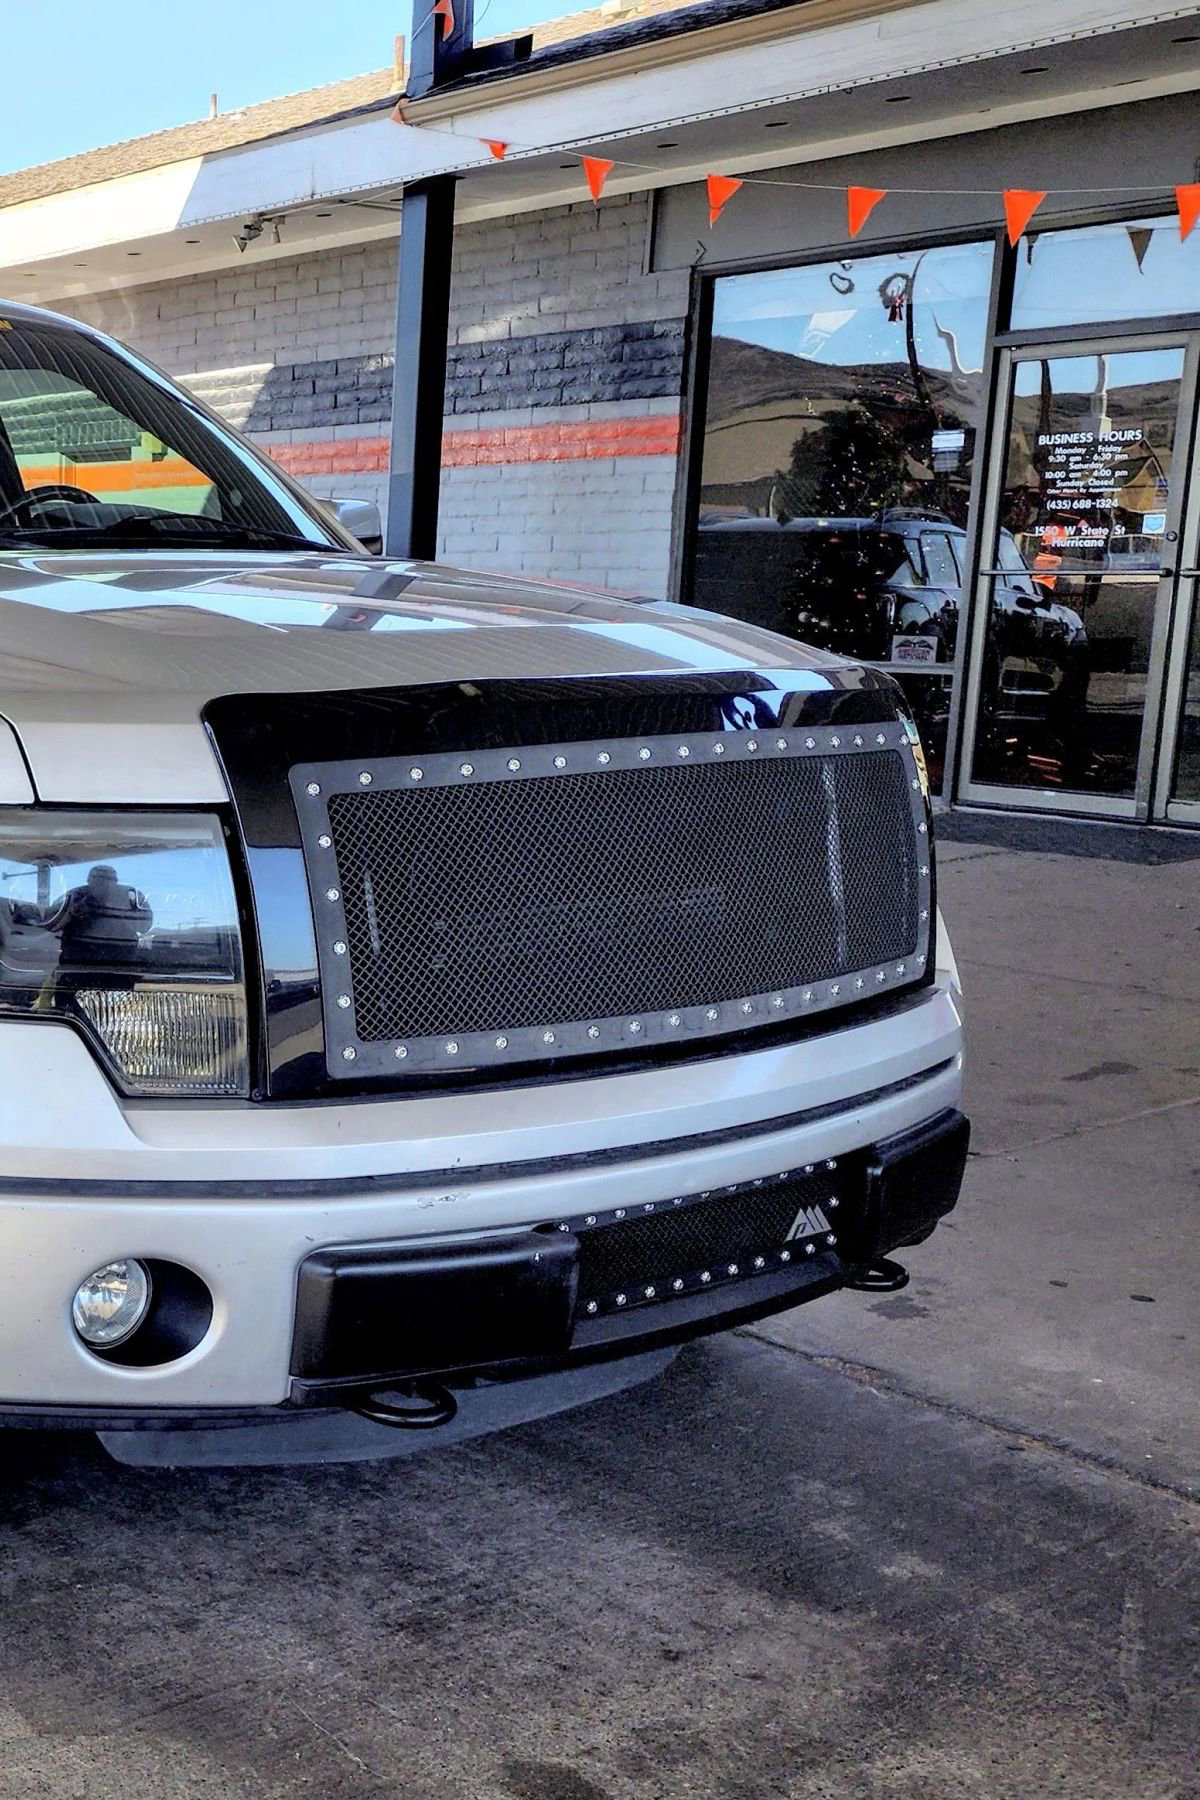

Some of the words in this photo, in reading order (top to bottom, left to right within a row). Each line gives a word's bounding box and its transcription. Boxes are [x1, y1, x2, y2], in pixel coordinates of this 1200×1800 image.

[1038, 432, 1093, 445] BUSINESS
[1099, 430, 1142, 442] HOURS
[1098, 445, 1122, 453] Friday
[1048, 455, 1066, 463] 9:30
[1093, 453, 1112, 461] 6:30
[1115, 453, 1128, 461] pm
[1068, 462, 1104, 470] Saturday
[1044, 471, 1066, 479] 10:00
[1092, 469, 1112, 477] 4:00
[1056, 480, 1085, 488] Sunday
[1088, 478, 1114, 486] Closed
[1046, 500, 1071, 511] (435)
[1072, 498, 1119, 509] 688-1324
[1064, 525, 1076, 535] W
[1081, 526, 1109, 535] State
[1114, 525, 1126, 535] St
[1051, 538, 1105, 547] Hurricane
